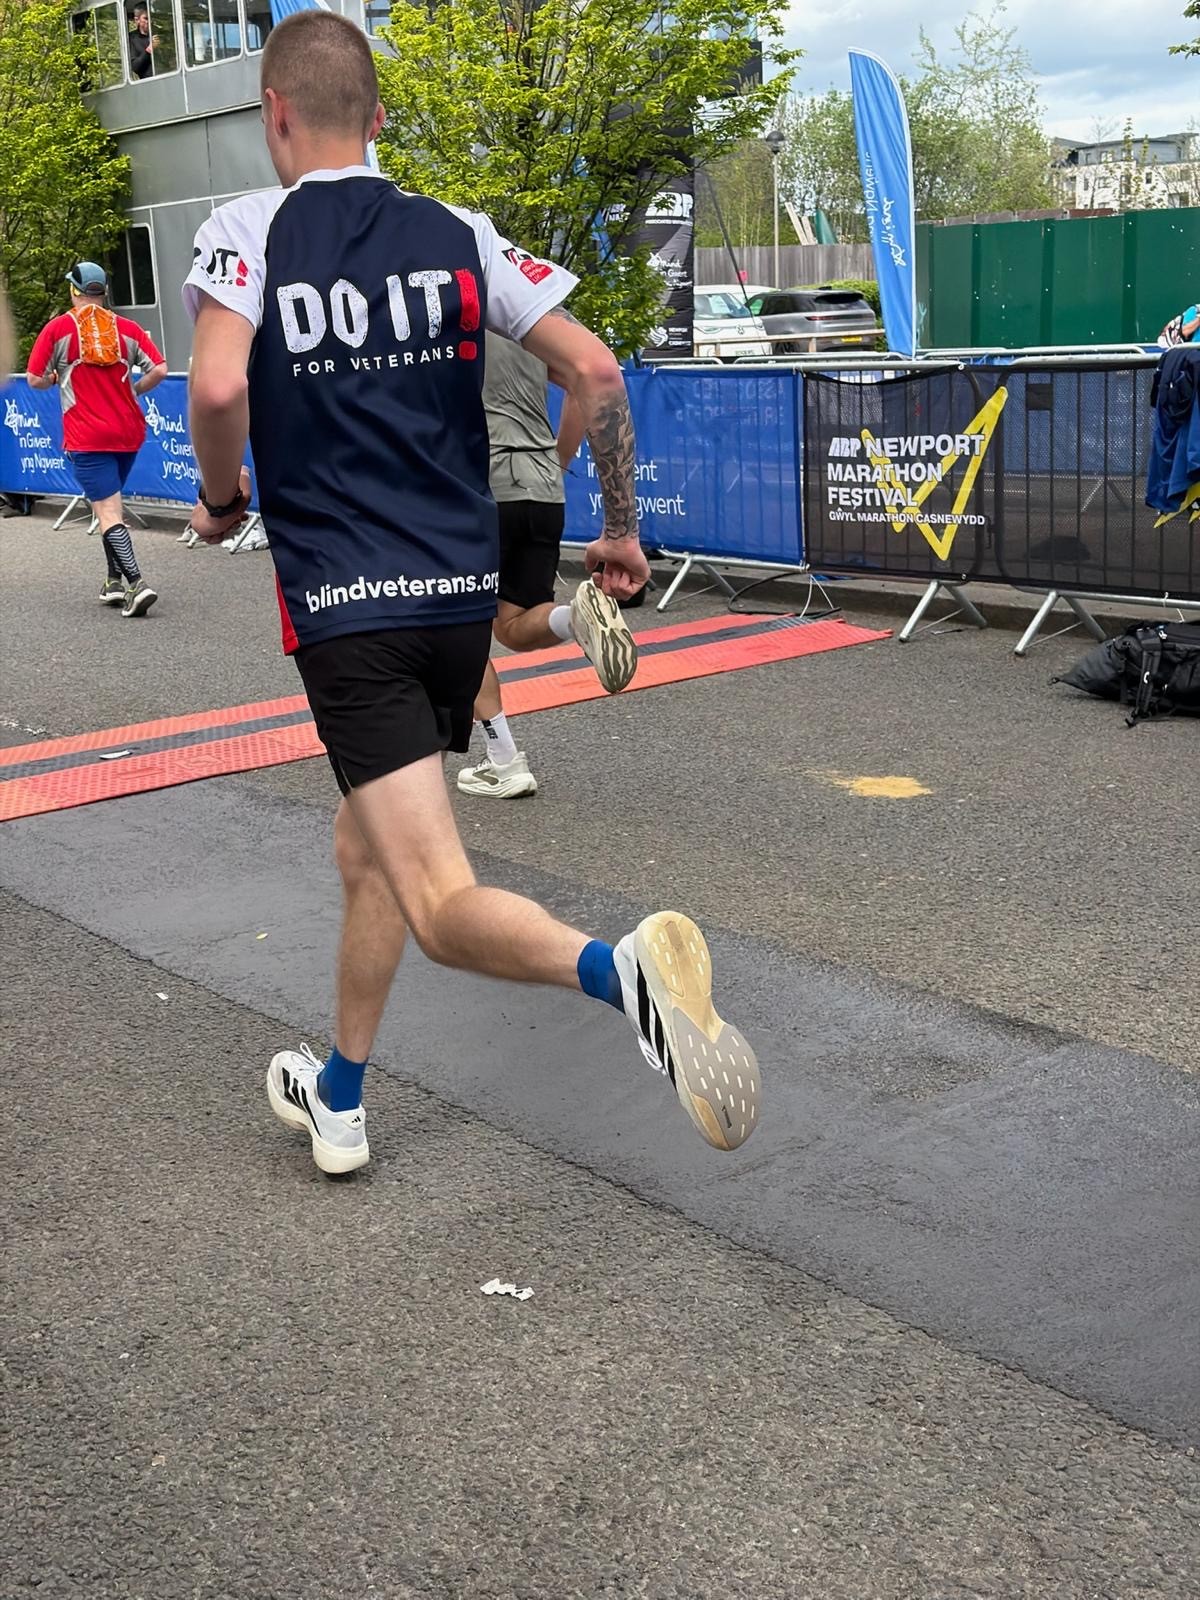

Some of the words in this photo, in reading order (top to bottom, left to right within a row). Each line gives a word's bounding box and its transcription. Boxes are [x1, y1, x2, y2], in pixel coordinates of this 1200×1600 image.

[277, 278, 370, 354] DO
[386, 268, 480, 360] IT!
[293, 359, 335, 376] FOR
[350, 345, 455, 372] VETERANS
[828, 437, 861, 457] ABP
[866, 434, 985, 457] NEWPORT
[827, 462, 943, 483] MARATHON
[635, 493, 686, 520] gwent
[857, 512, 914, 524] MARATHON
[915, 513, 986, 526] CASNEWYDD
[306, 569, 499, 613] blindveterans.org
